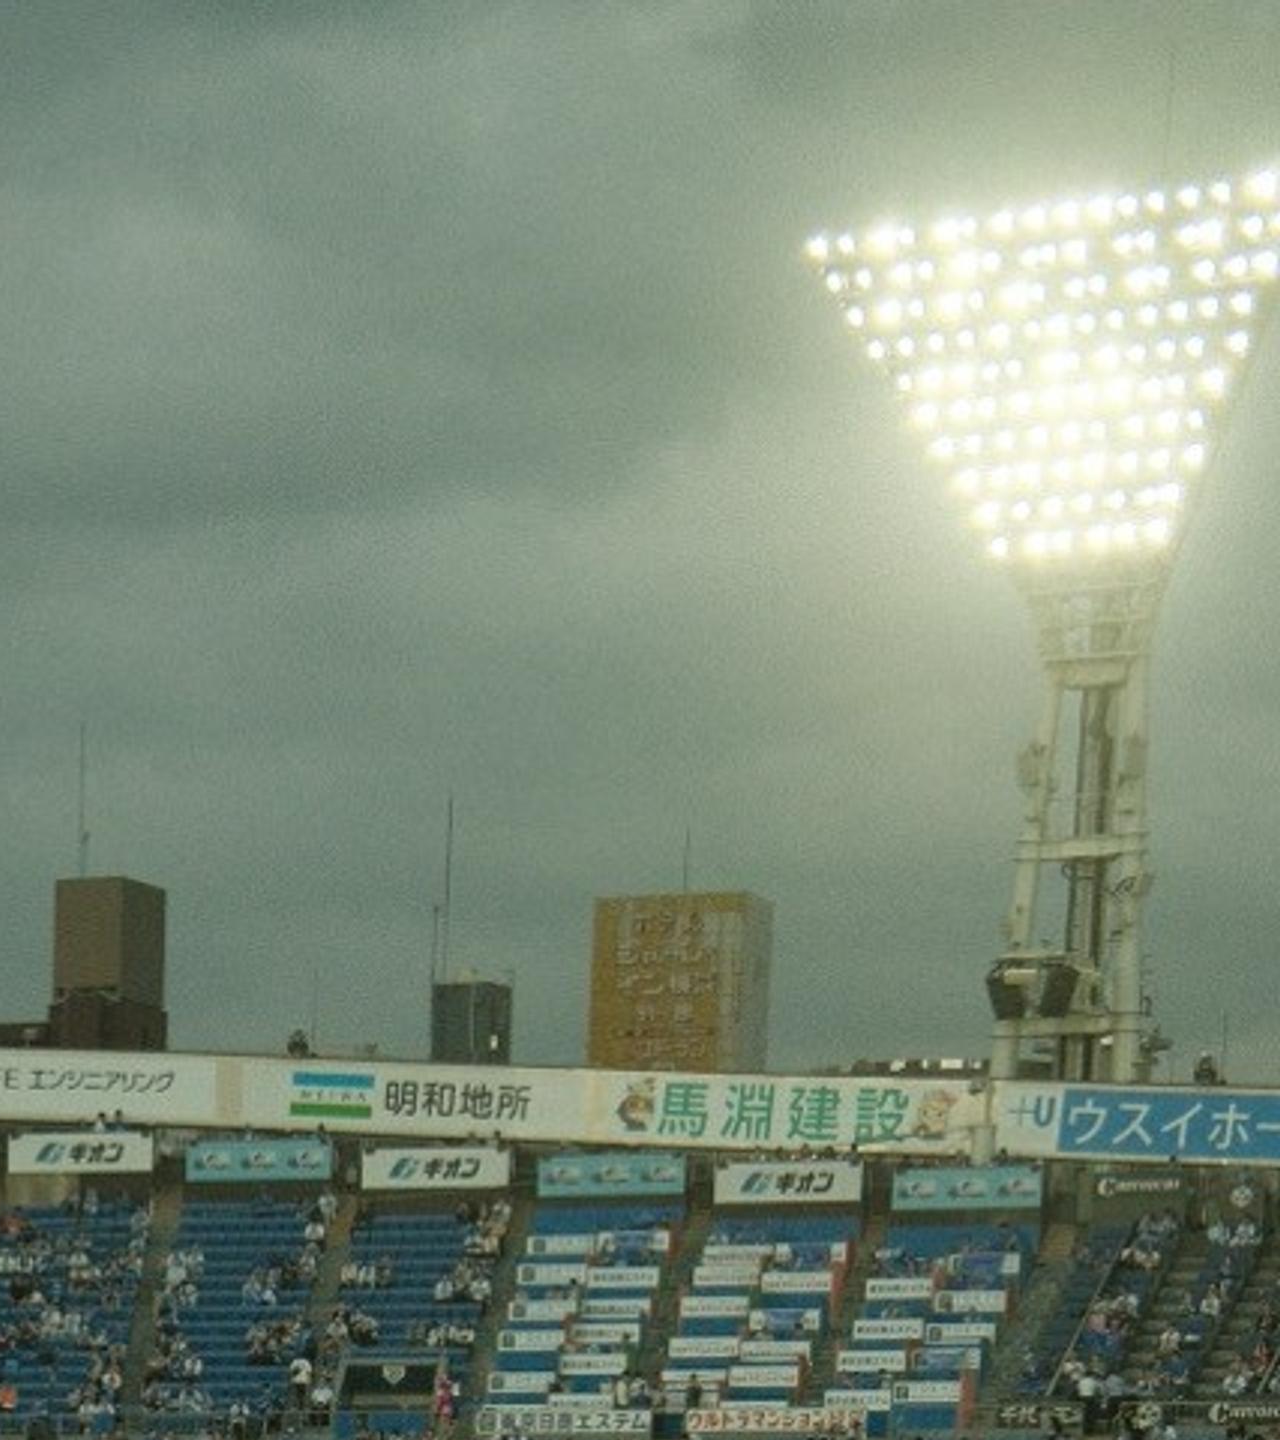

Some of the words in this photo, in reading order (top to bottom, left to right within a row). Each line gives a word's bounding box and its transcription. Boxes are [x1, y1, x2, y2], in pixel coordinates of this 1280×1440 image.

[28, 1070, 174, 1093] エンジニアリング
[385, 1081, 532, 1121] 明和地所
